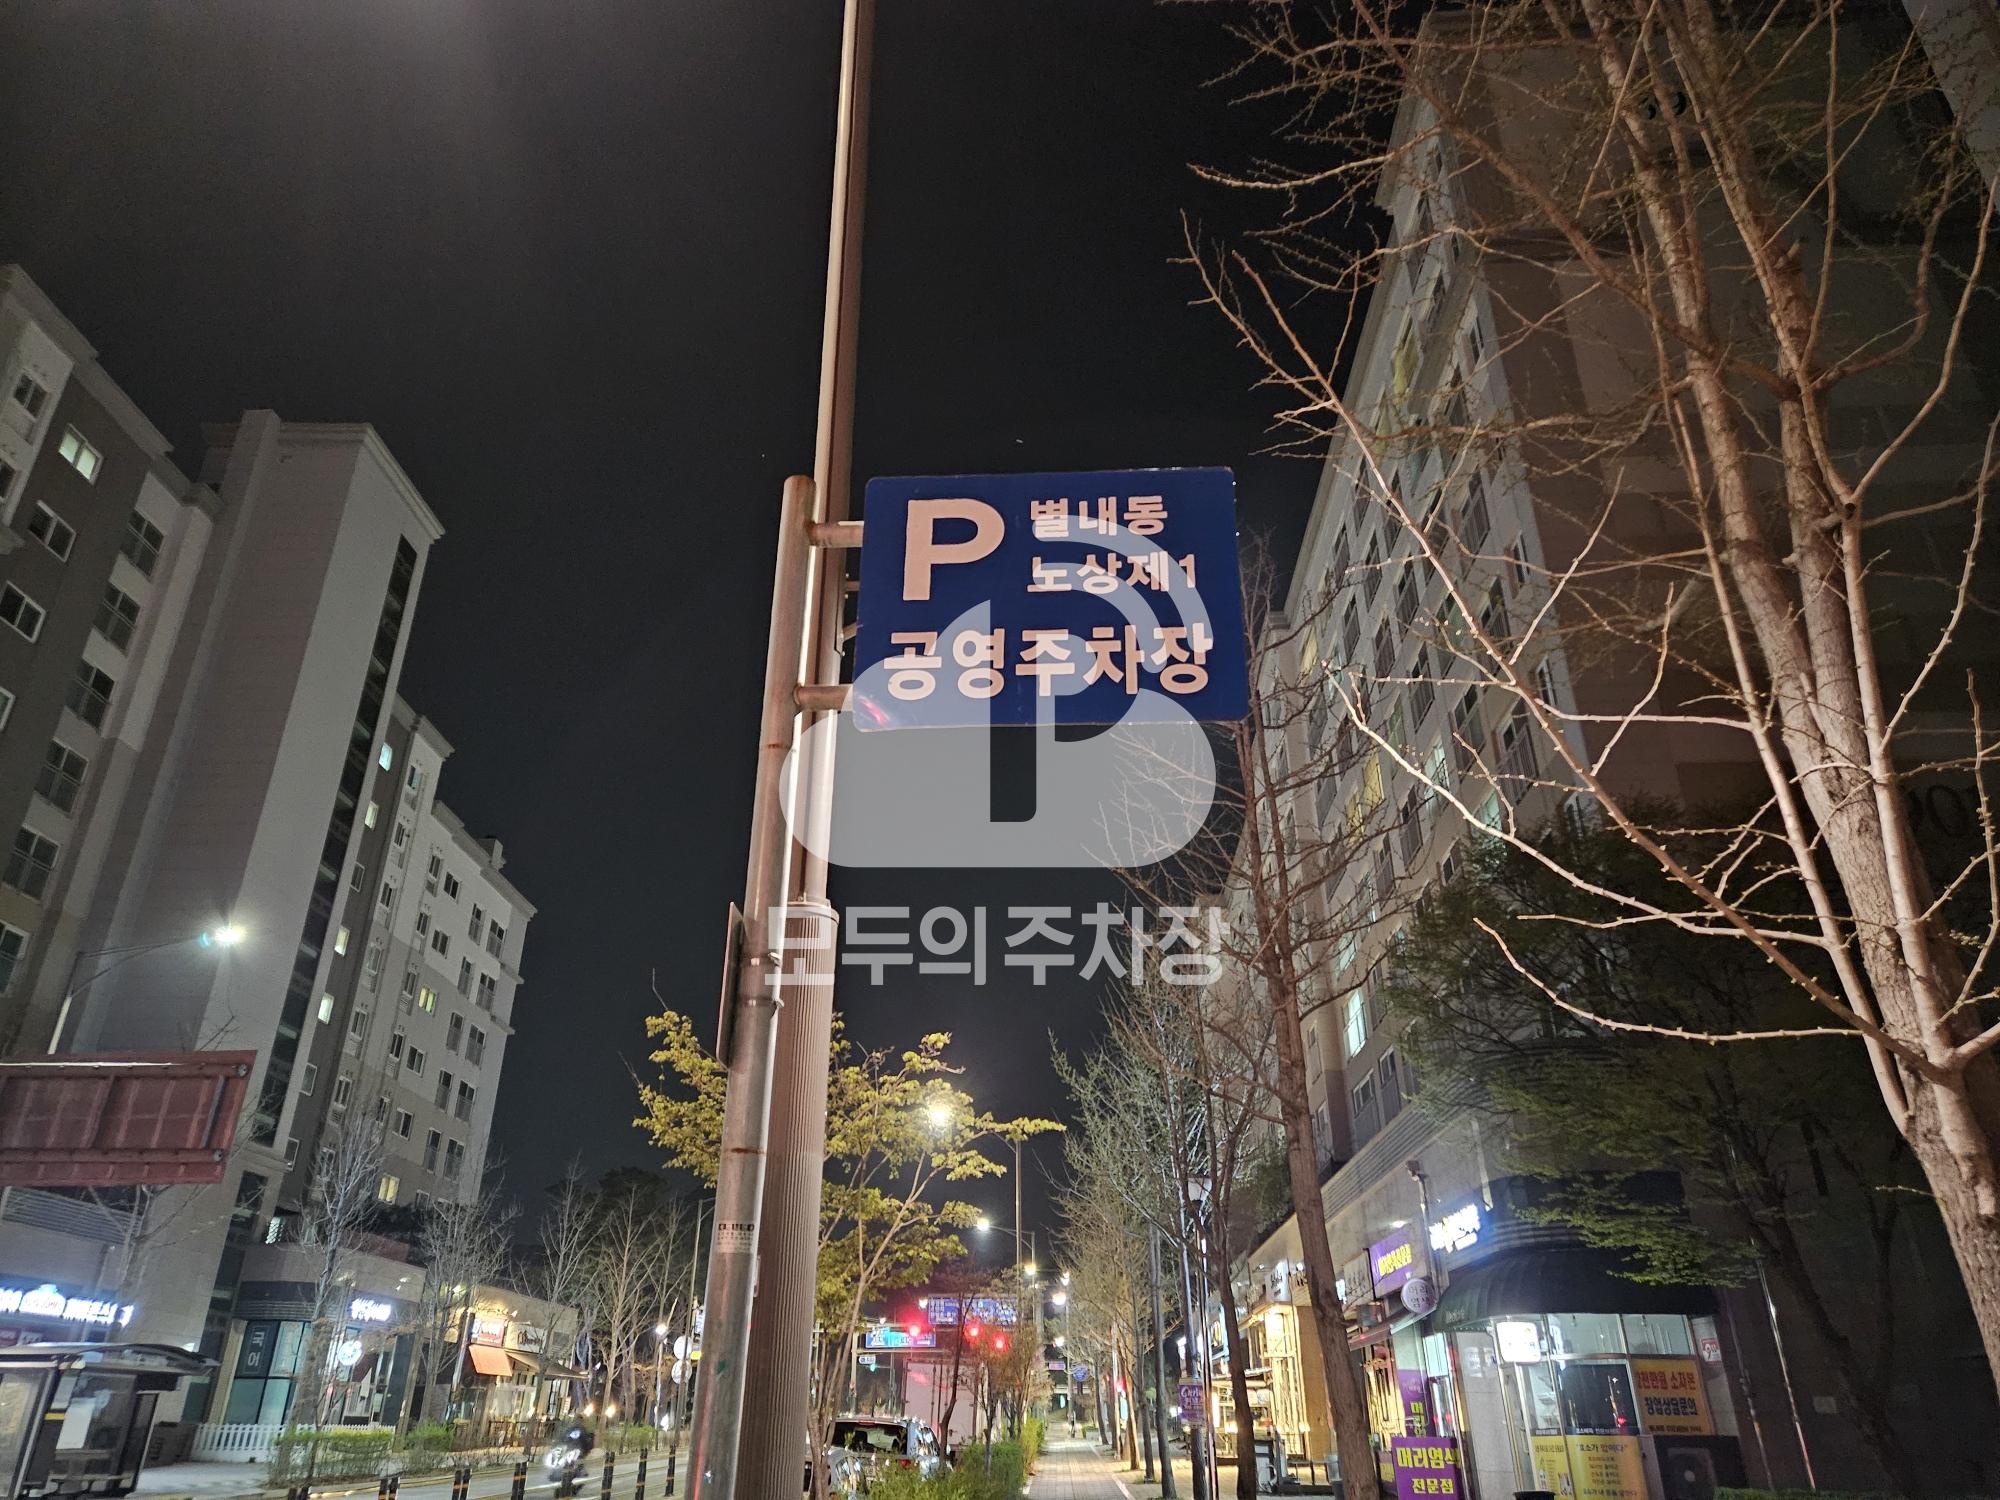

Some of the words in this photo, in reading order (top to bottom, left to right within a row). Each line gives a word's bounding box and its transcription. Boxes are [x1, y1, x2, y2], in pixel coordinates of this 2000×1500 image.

[1030, 495, 1168, 537] 별내동
[903, 498, 1005, 600] P
[1027, 551, 1196, 592] 노상제1
[883, 623, 1213, 700] 공영주차장
